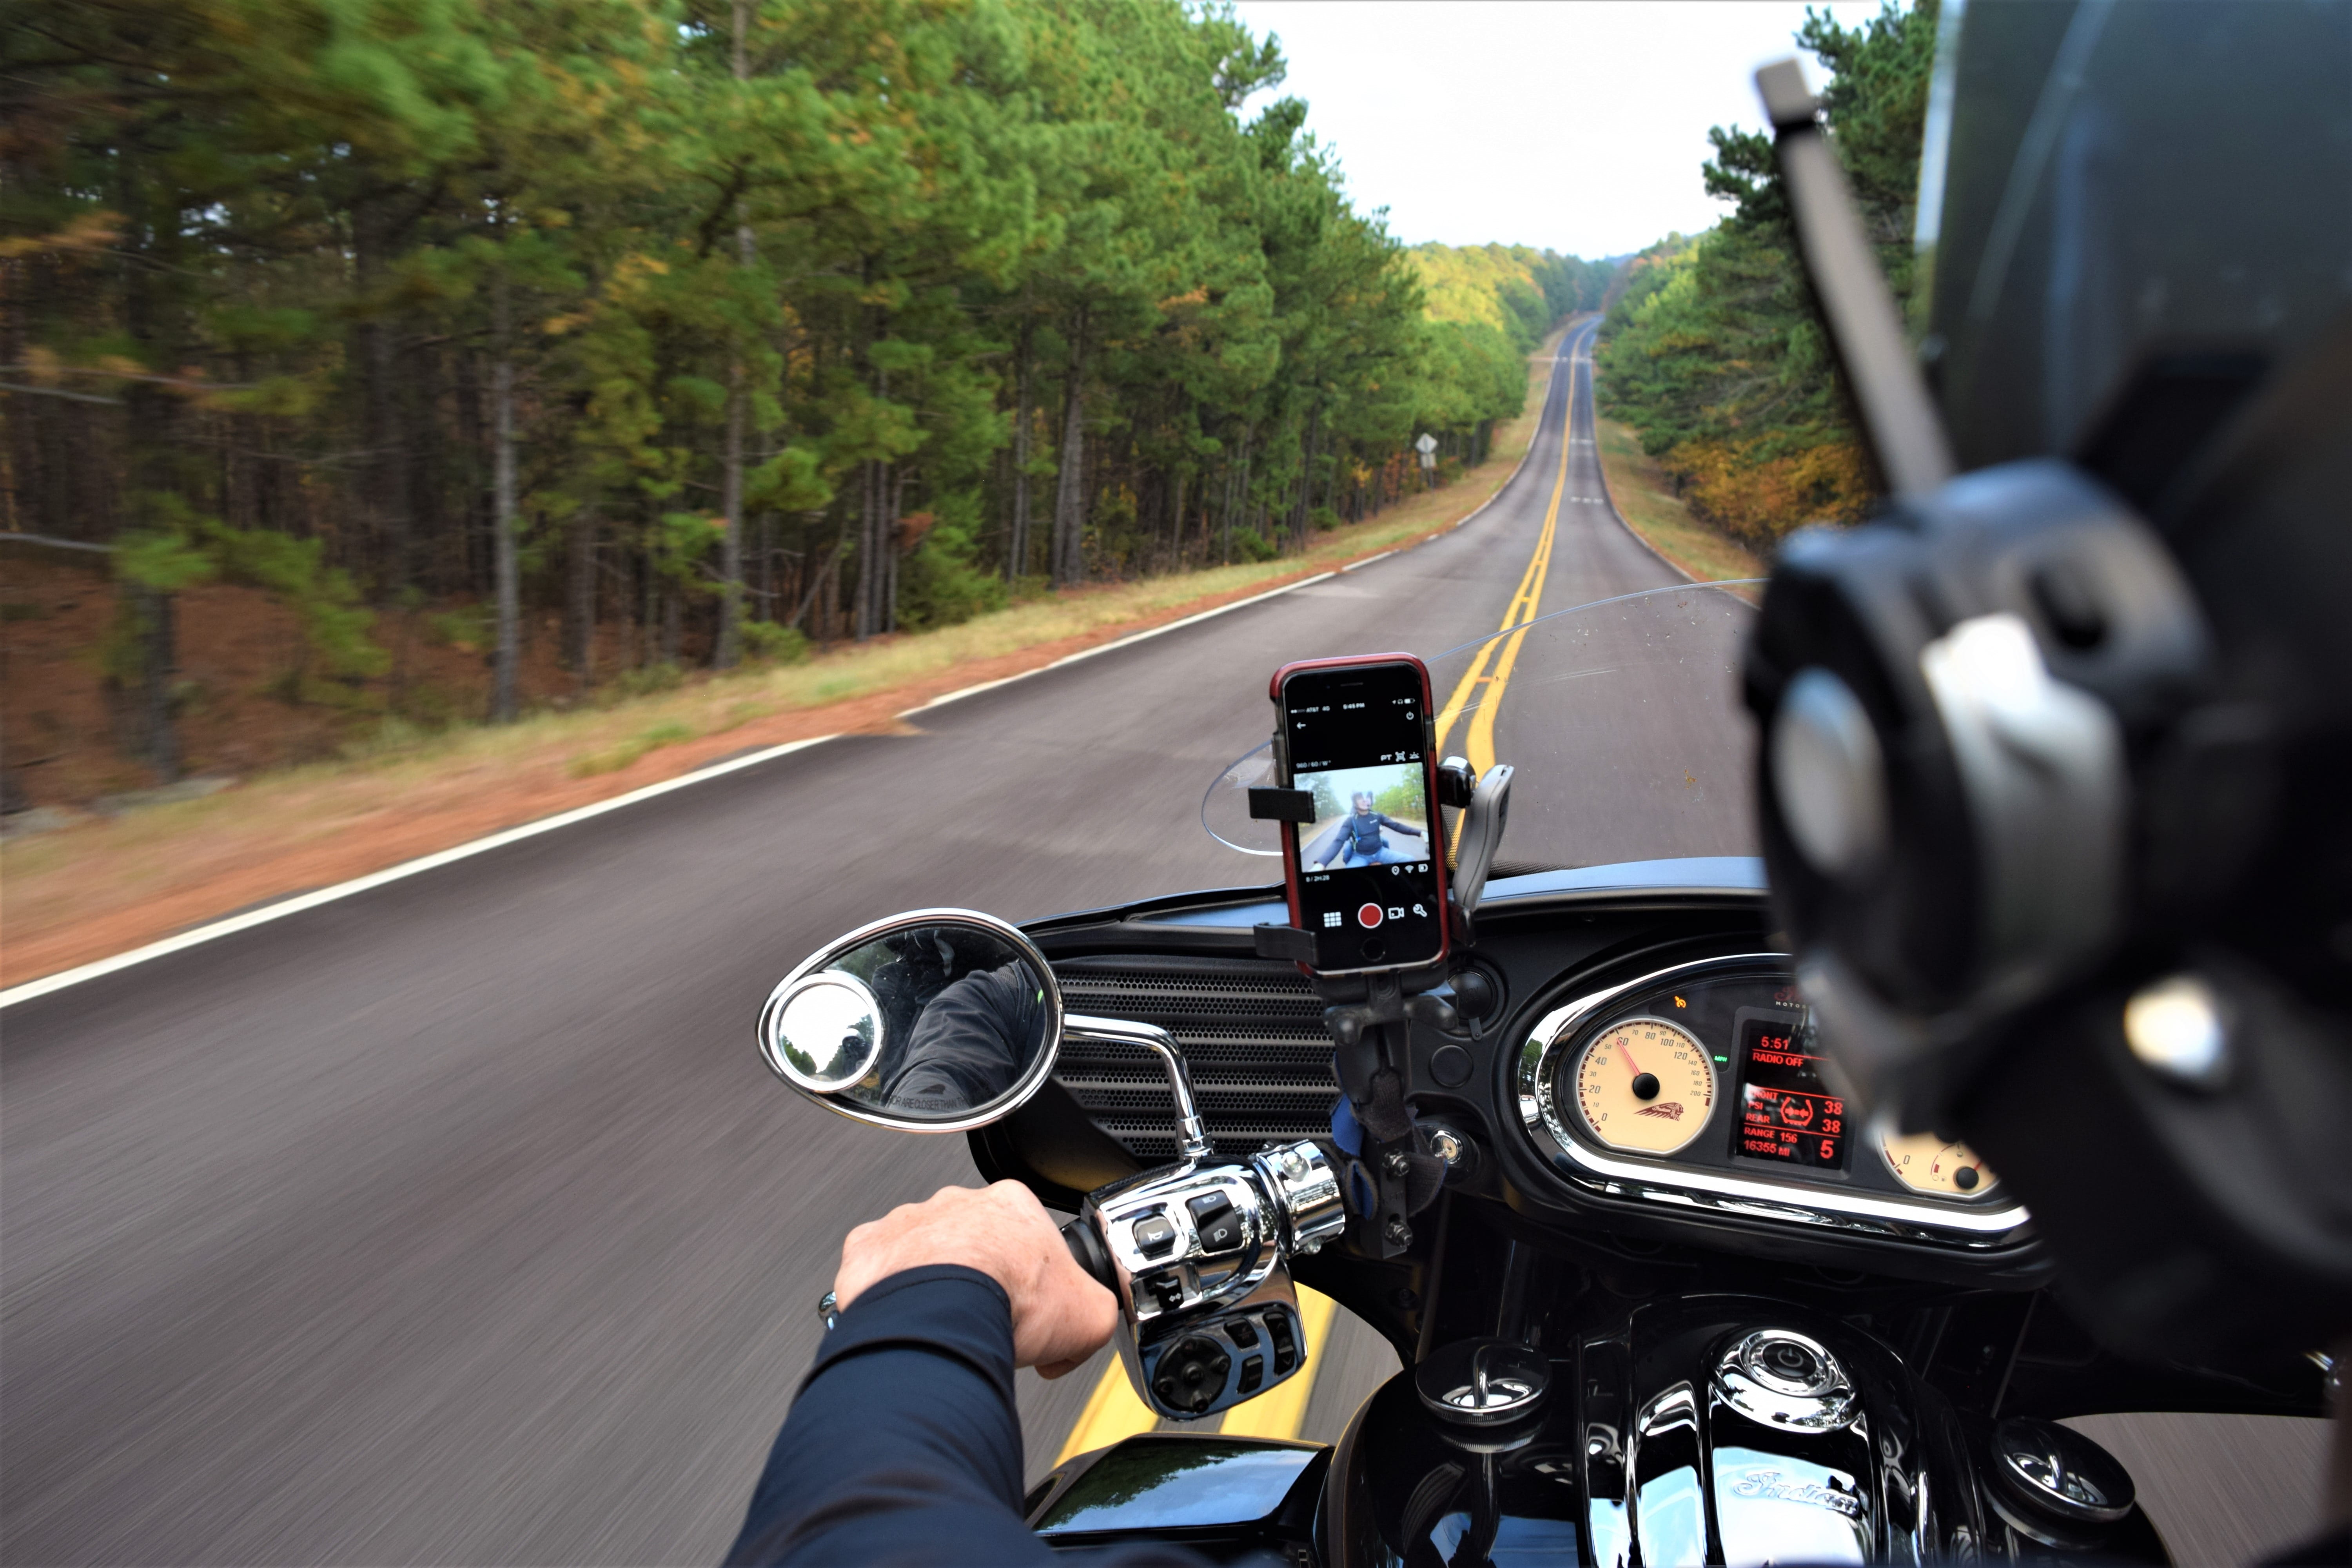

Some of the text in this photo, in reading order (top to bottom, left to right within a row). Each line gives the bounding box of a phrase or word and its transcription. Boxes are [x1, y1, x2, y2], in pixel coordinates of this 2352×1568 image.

[1645, 1032, 1656, 1040] 80
[1617, 1037, 1629, 1046] 60
[1661, 1038, 1675, 1047] 100
[1761, 1036, 1789, 1050] 5:51
[1595, 1057, 1607, 1065] 40
[1674, 1052, 1688, 1060] 120
[1753, 1053, 1803, 1067] RADIO OFF
[1589, 1085, 1601, 1094] 20
[1748, 1101, 1763, 1110] PSI
[1824, 1100, 1843, 1115] 38
[1601, 1113, 1608, 1121] 0
[1746, 1112, 1770, 1123] REAR
[1822, 1119, 1841, 1133] 38
[1744, 1127, 1797, 1143] RANGE 156
[1744, 1140, 1790, 1156] 16355 MI
[1820, 1140, 1834, 1159] 5
[1903, 1155, 1911, 1165] 0
[1733, 1472, 1859, 1515] Indian
